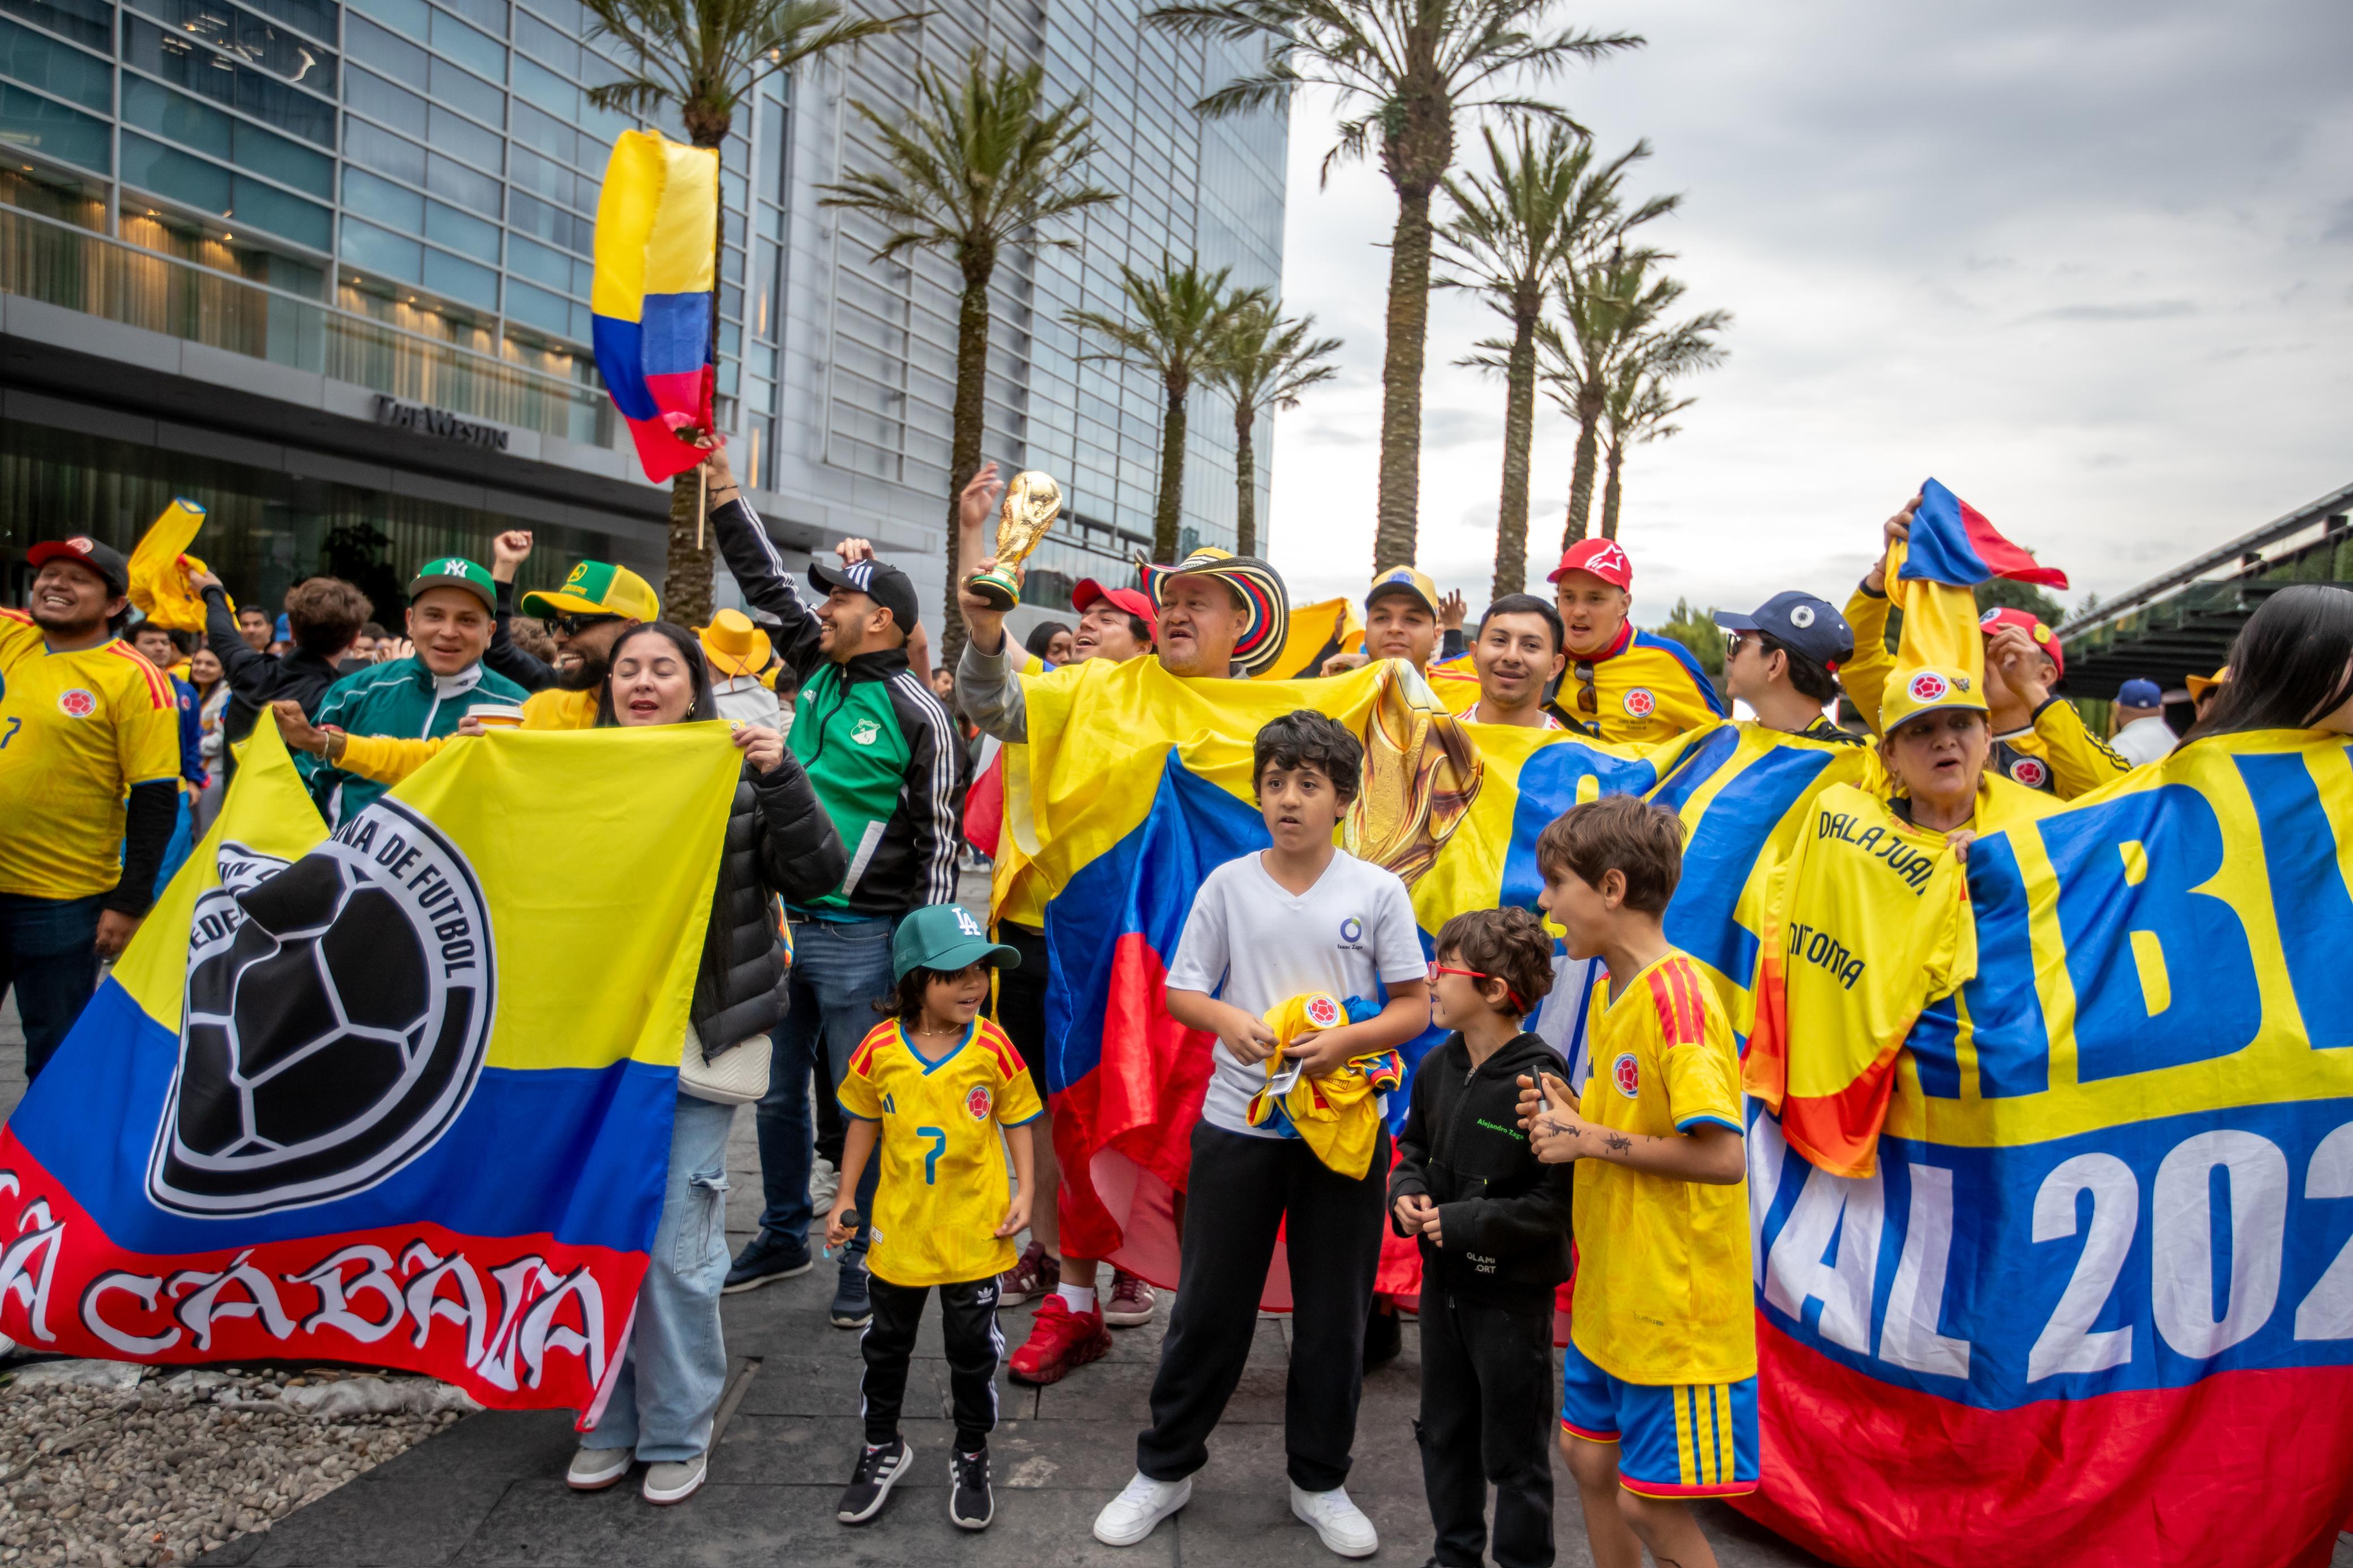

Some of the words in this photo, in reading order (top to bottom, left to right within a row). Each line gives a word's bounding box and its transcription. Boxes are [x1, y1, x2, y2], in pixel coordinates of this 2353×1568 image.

[444, 560, 468, 578] NY
[1, 716, 22, 750] 7
[374, 833, 423, 880] DE
[406, 863, 476, 979] FUTBOL
[951, 908, 981, 936] LA
[1477, 1118, 1508, 1134] Alejandro
[1509, 1129, 1524, 1141] Zaga
[916, 1126, 946, 1186] 7
[1466, 1251, 1496, 1264] OLAMI
